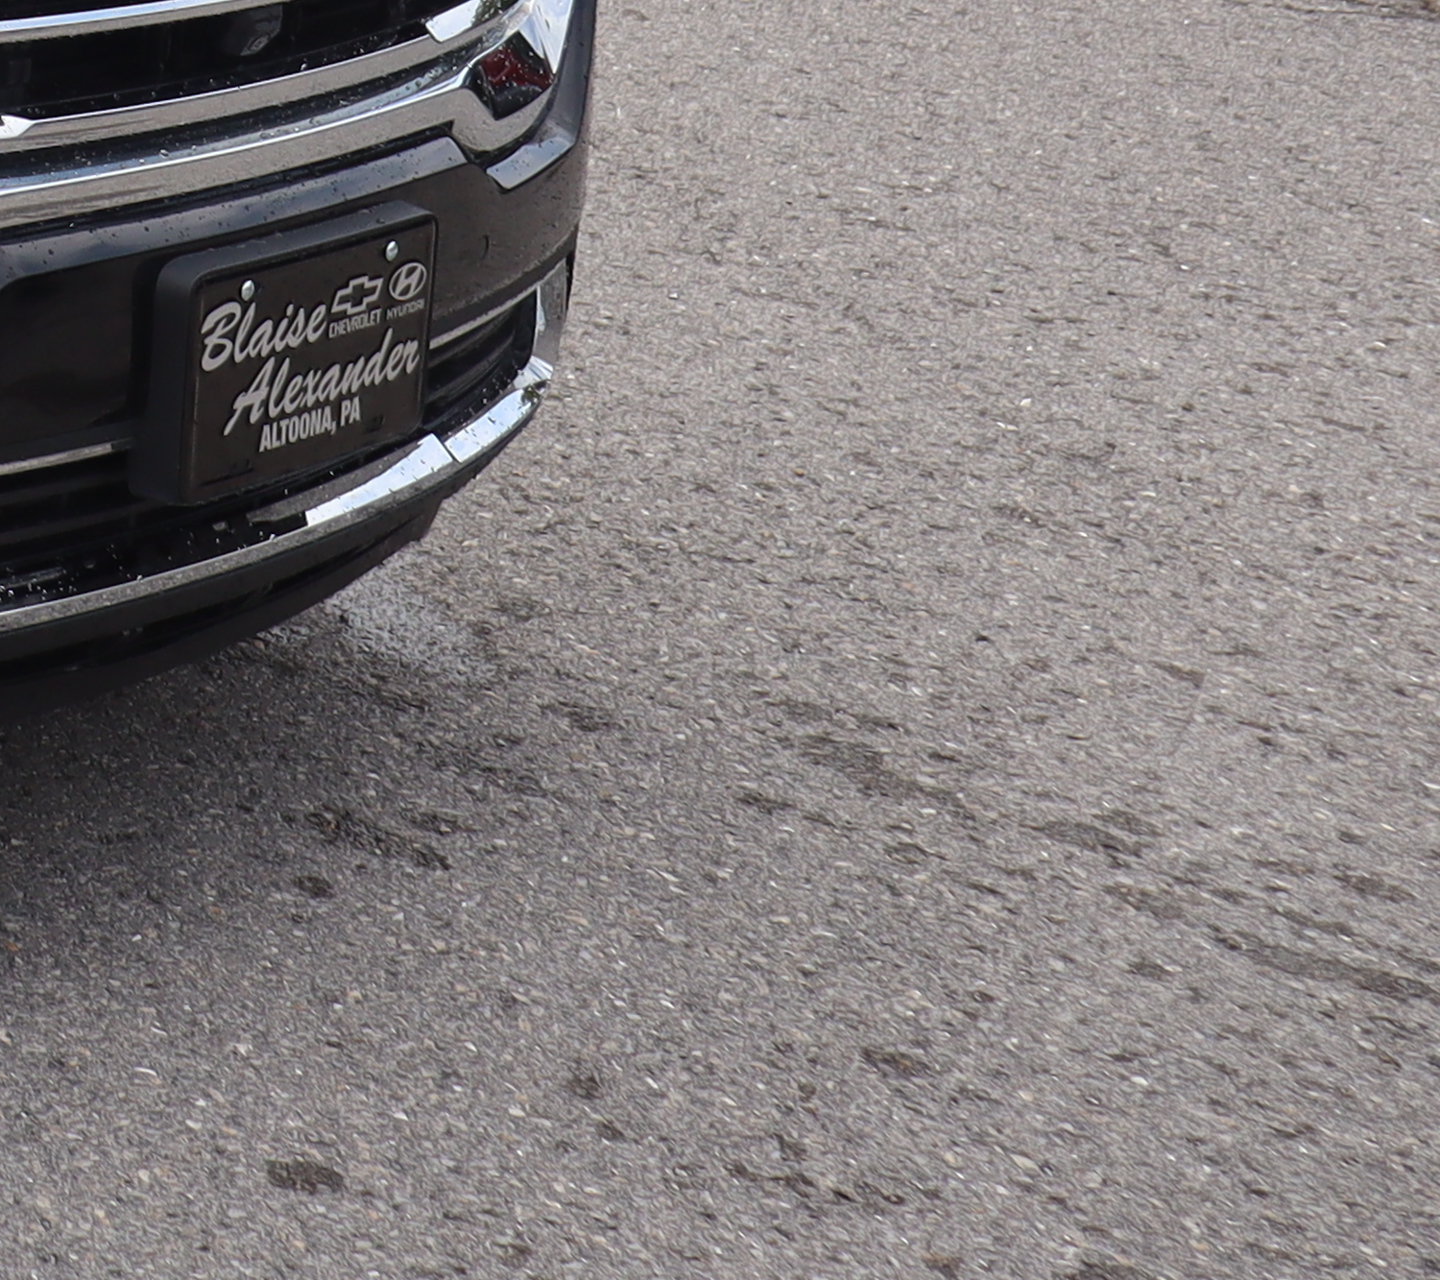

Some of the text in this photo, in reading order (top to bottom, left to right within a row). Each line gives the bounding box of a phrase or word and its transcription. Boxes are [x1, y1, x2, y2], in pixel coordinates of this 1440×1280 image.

[200, 300, 328, 372] Blaise
[328, 297, 425, 338] CHEVROLET HYUNDAI
[223, 327, 421, 436] Alexander
[258, 395, 361, 453] ALTOONA, PA
